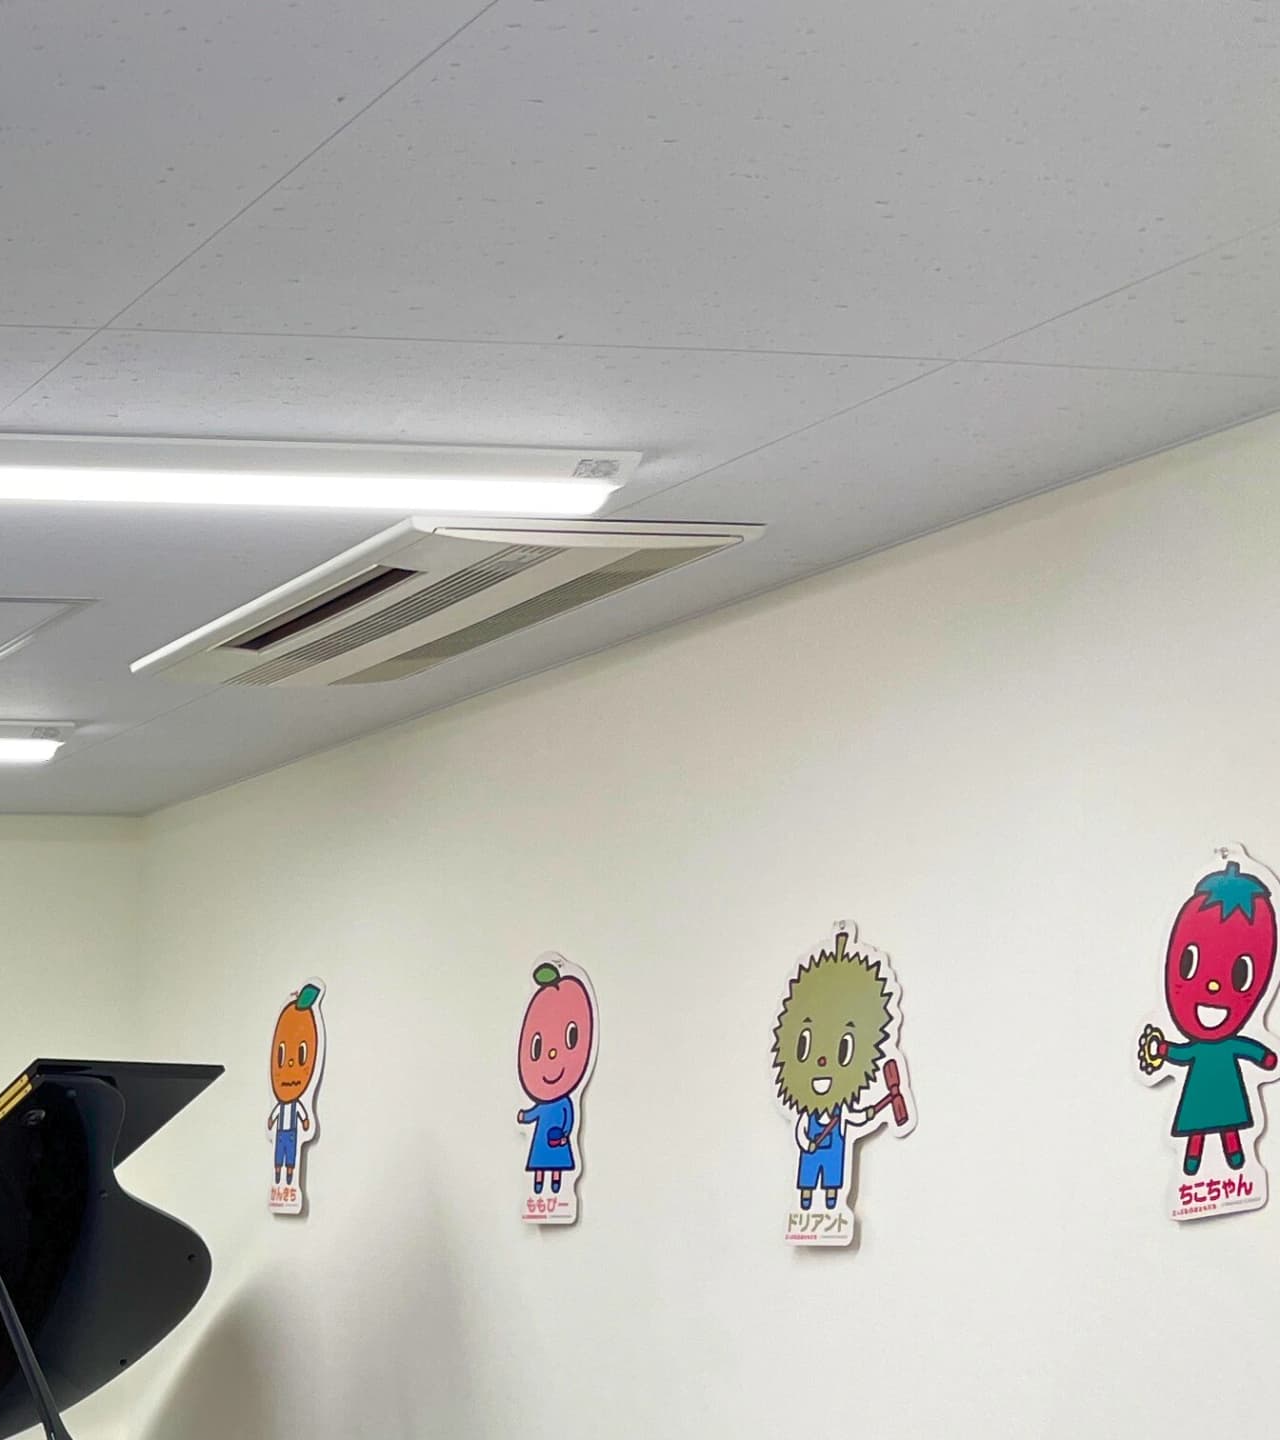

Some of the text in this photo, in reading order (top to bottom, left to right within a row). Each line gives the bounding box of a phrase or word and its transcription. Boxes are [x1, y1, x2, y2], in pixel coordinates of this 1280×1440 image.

[1178, 1173, 1254, 1206] ちこちゃん
[787, 1213, 849, 1233] ドリアント
